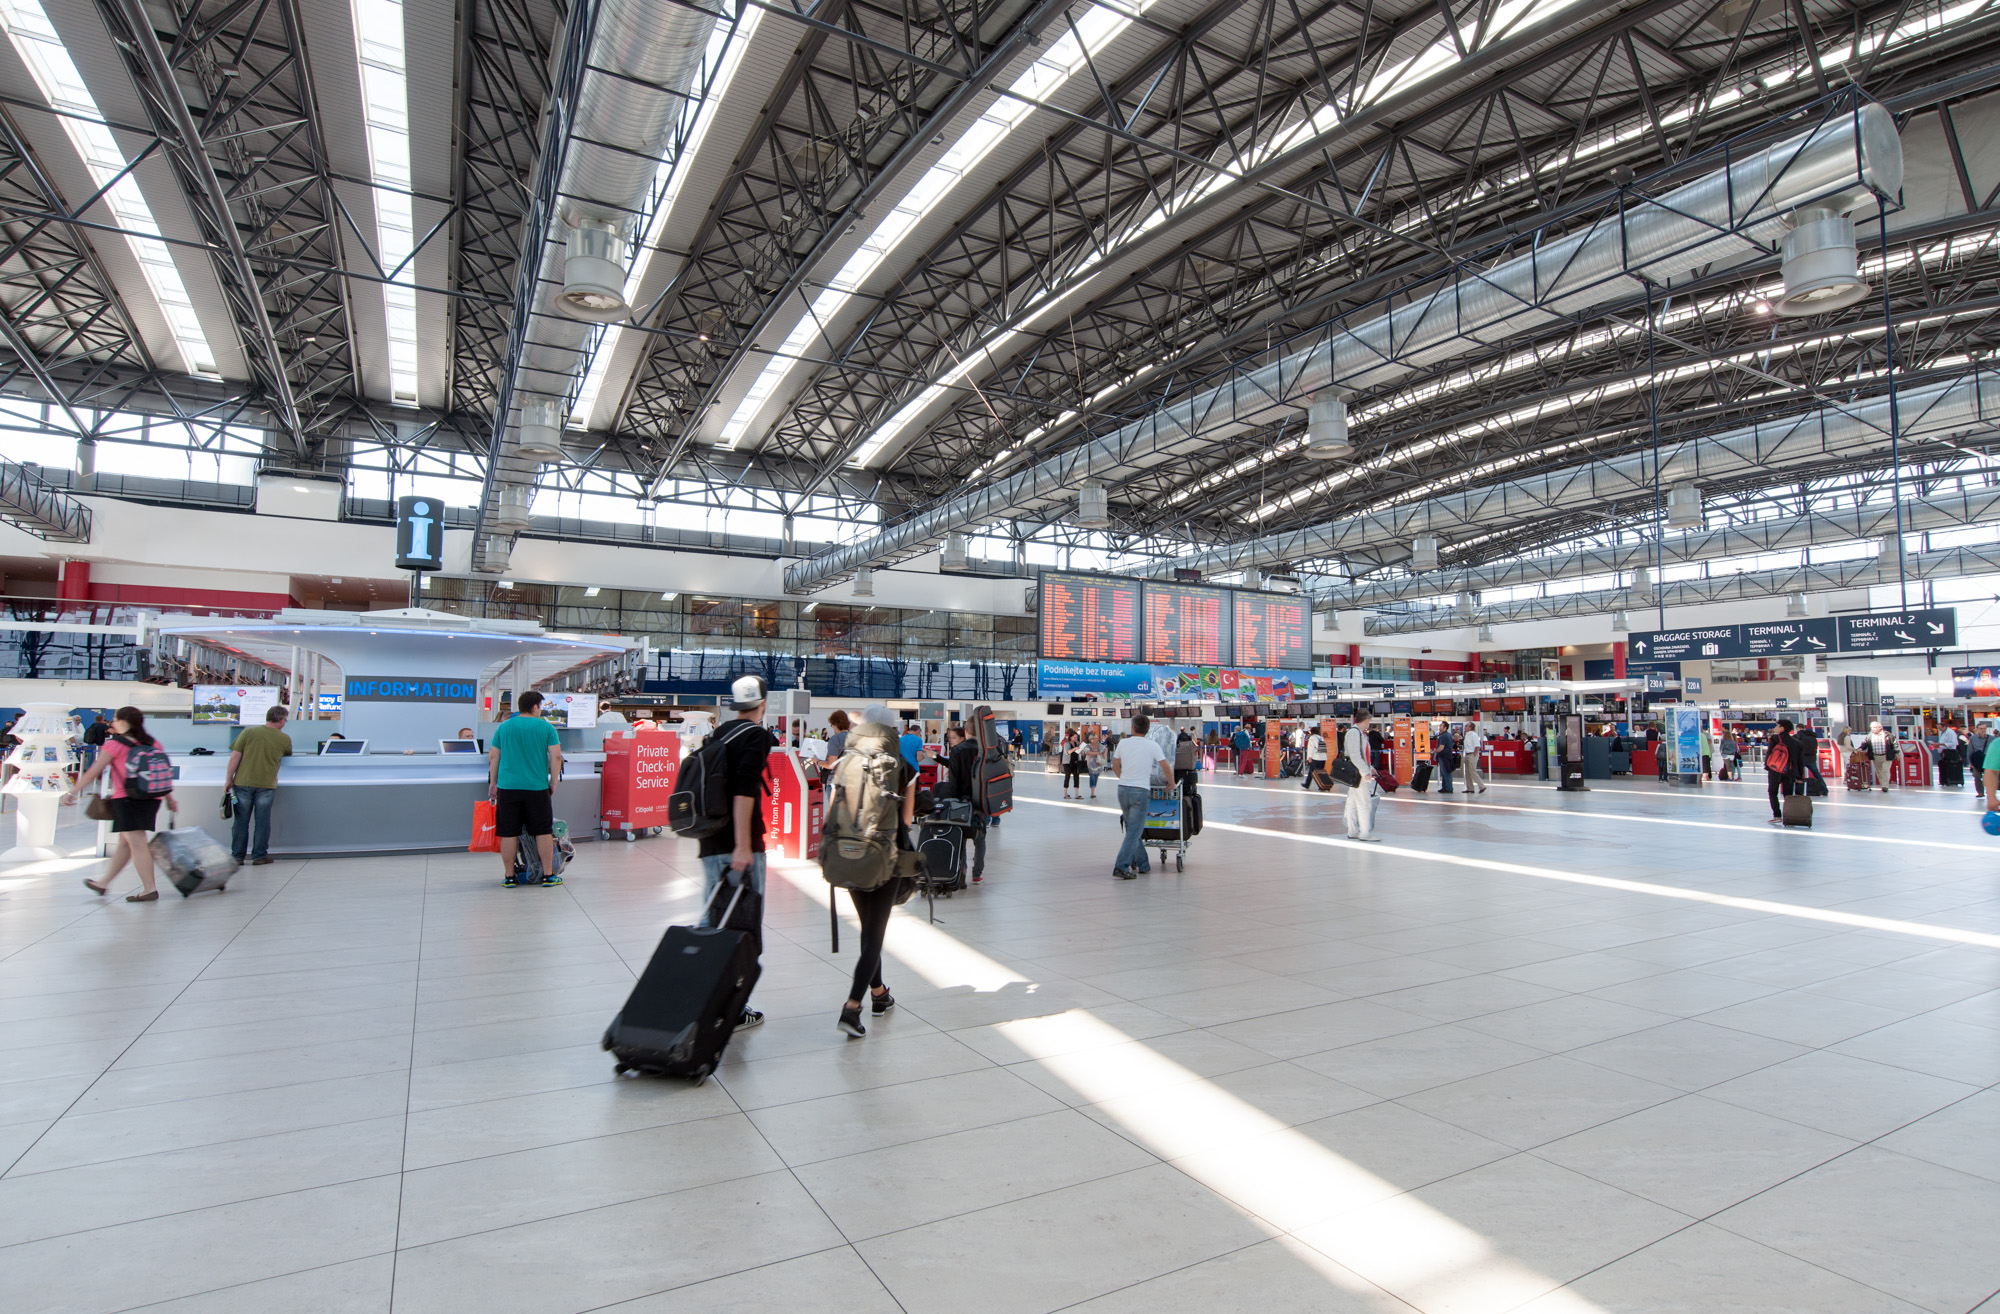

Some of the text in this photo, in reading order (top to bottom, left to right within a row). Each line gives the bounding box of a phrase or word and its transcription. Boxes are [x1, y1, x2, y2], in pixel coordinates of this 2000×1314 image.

[1850, 616, 1915, 628] TERMINAL 2
[1653, 629, 1732, 643] BAGGAGE STORAGE
[1749, 625, 1796, 636] TERMINAL
[1044, 664, 1125, 677] Podnikejte bez hranic.
[348, 681, 474, 698] INFORMATION
[1137, 682, 1149, 690] citi
[637, 745, 668, 757] Private
[636, 760, 674, 773] Check-in
[636, 776, 668, 789] Service
[772, 778, 780, 805] Prague
[770, 826, 780, 839] Fly
